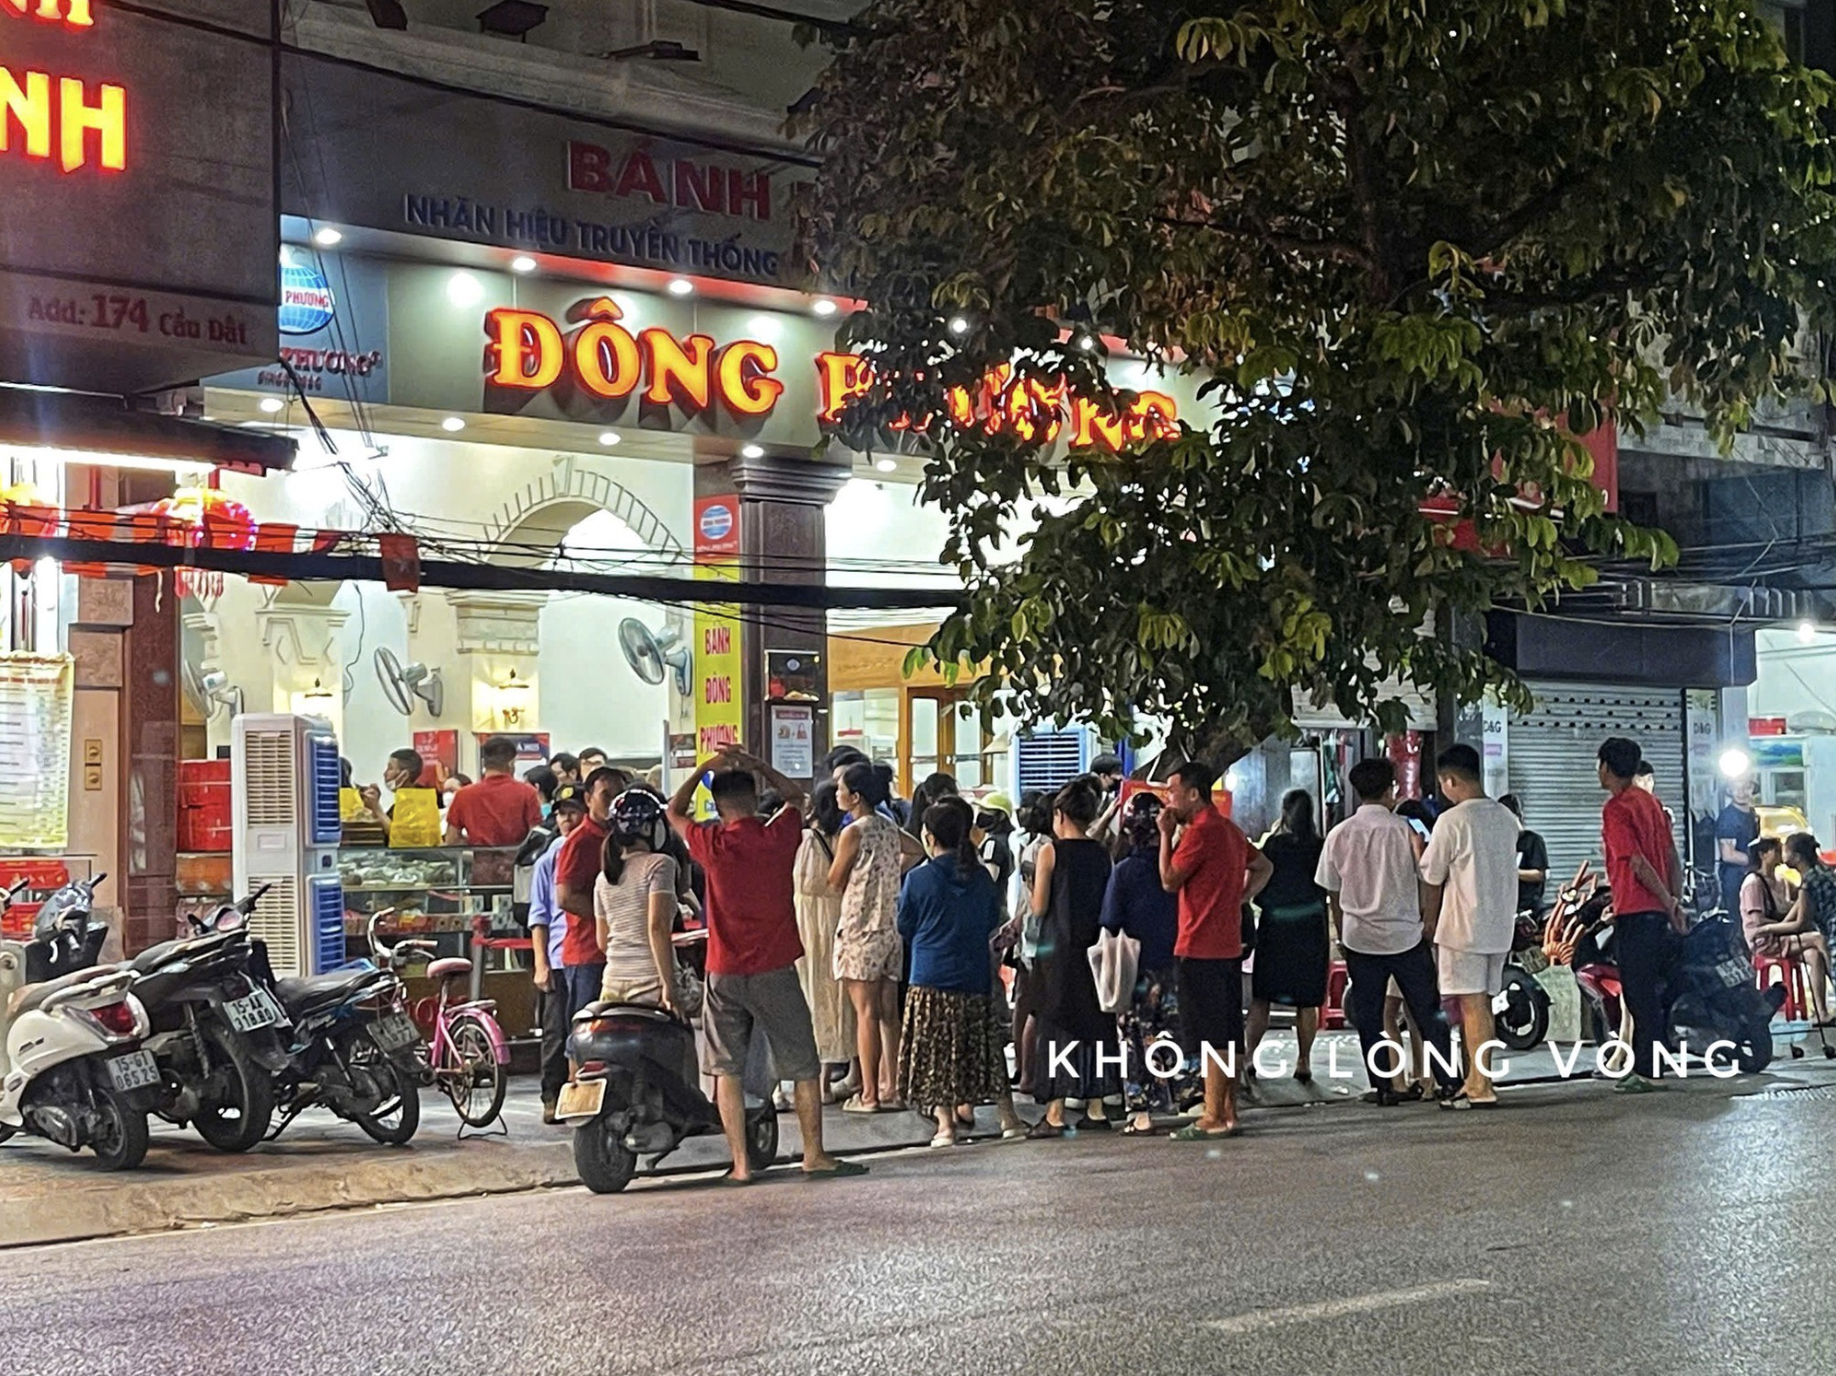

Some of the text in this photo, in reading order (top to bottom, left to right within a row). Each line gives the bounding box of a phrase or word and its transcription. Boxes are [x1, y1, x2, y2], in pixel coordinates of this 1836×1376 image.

[567, 137, 771, 221] BÁNH
[575, 218, 680, 264] TRUYỀN
[688, 233, 780, 277] THỐNG
[28, 296, 85, 326] Add:
[89, 294, 149, 333] 174
[486, 296, 784, 415] ĐÔNG
